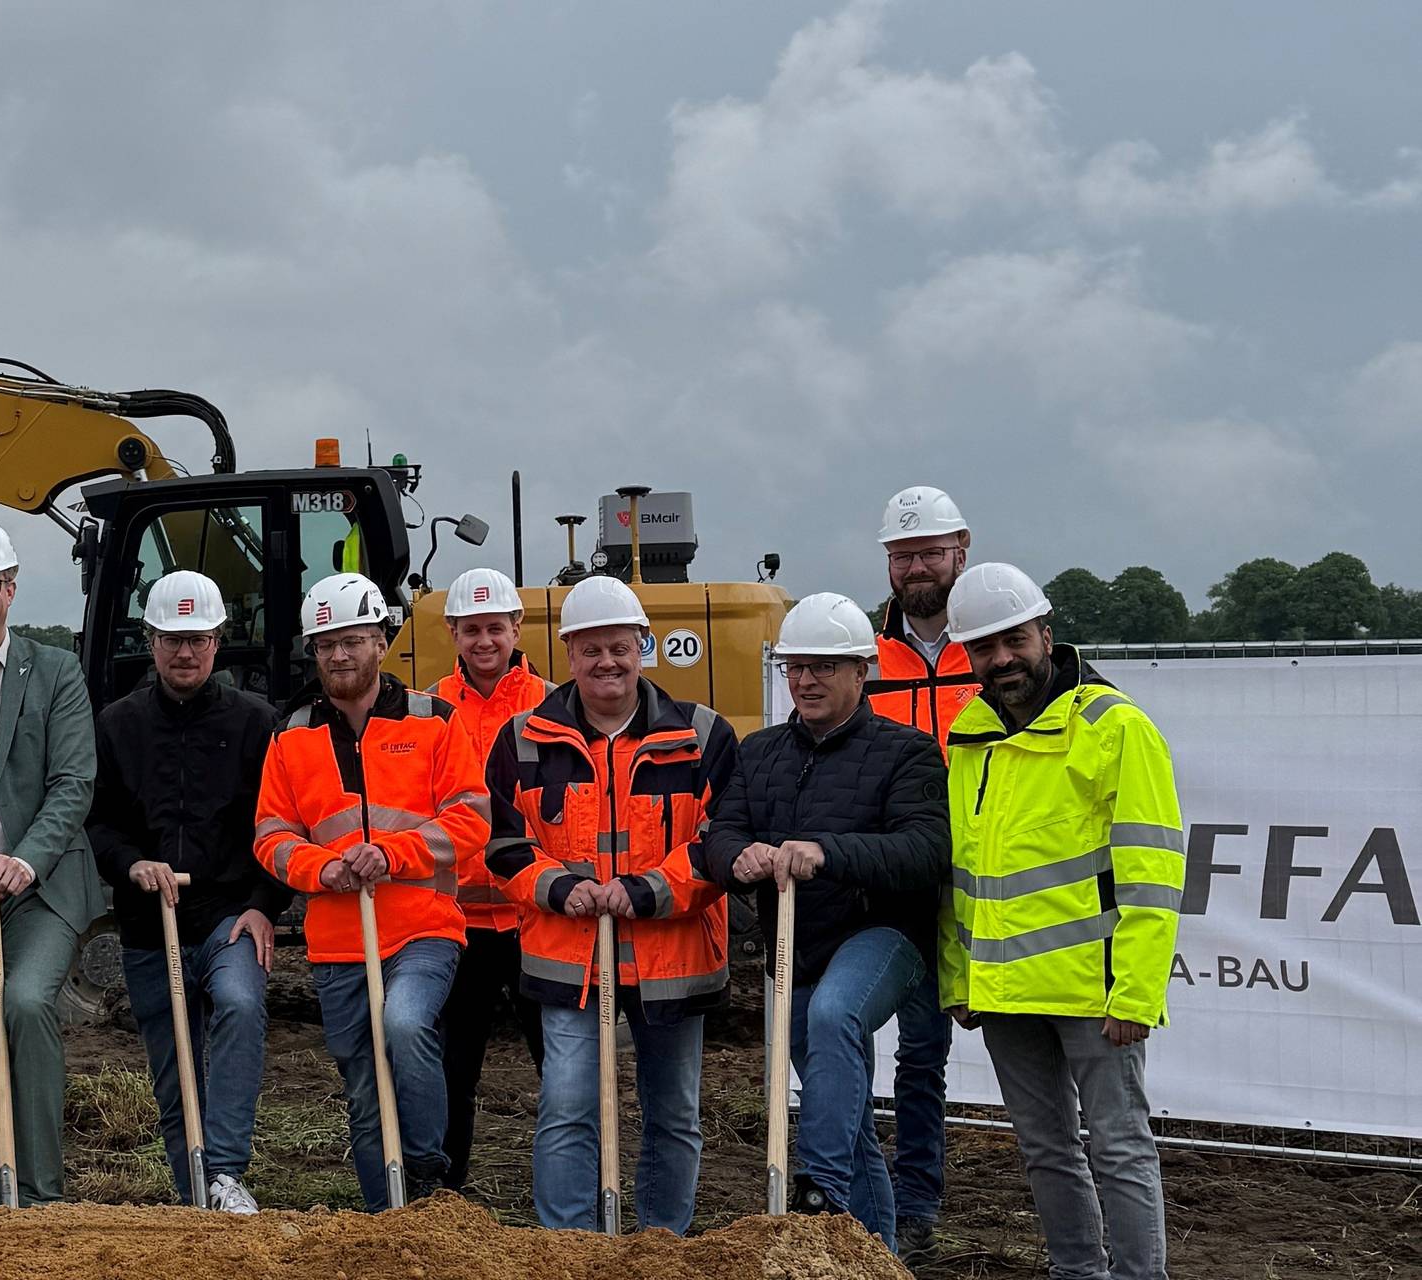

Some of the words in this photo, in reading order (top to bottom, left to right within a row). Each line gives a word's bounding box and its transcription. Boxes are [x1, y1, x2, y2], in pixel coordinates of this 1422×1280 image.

[292, 492, 344, 512] M318
[667, 636, 698, 657] 20
[1169, 952, 1310, 992] A-BAU
